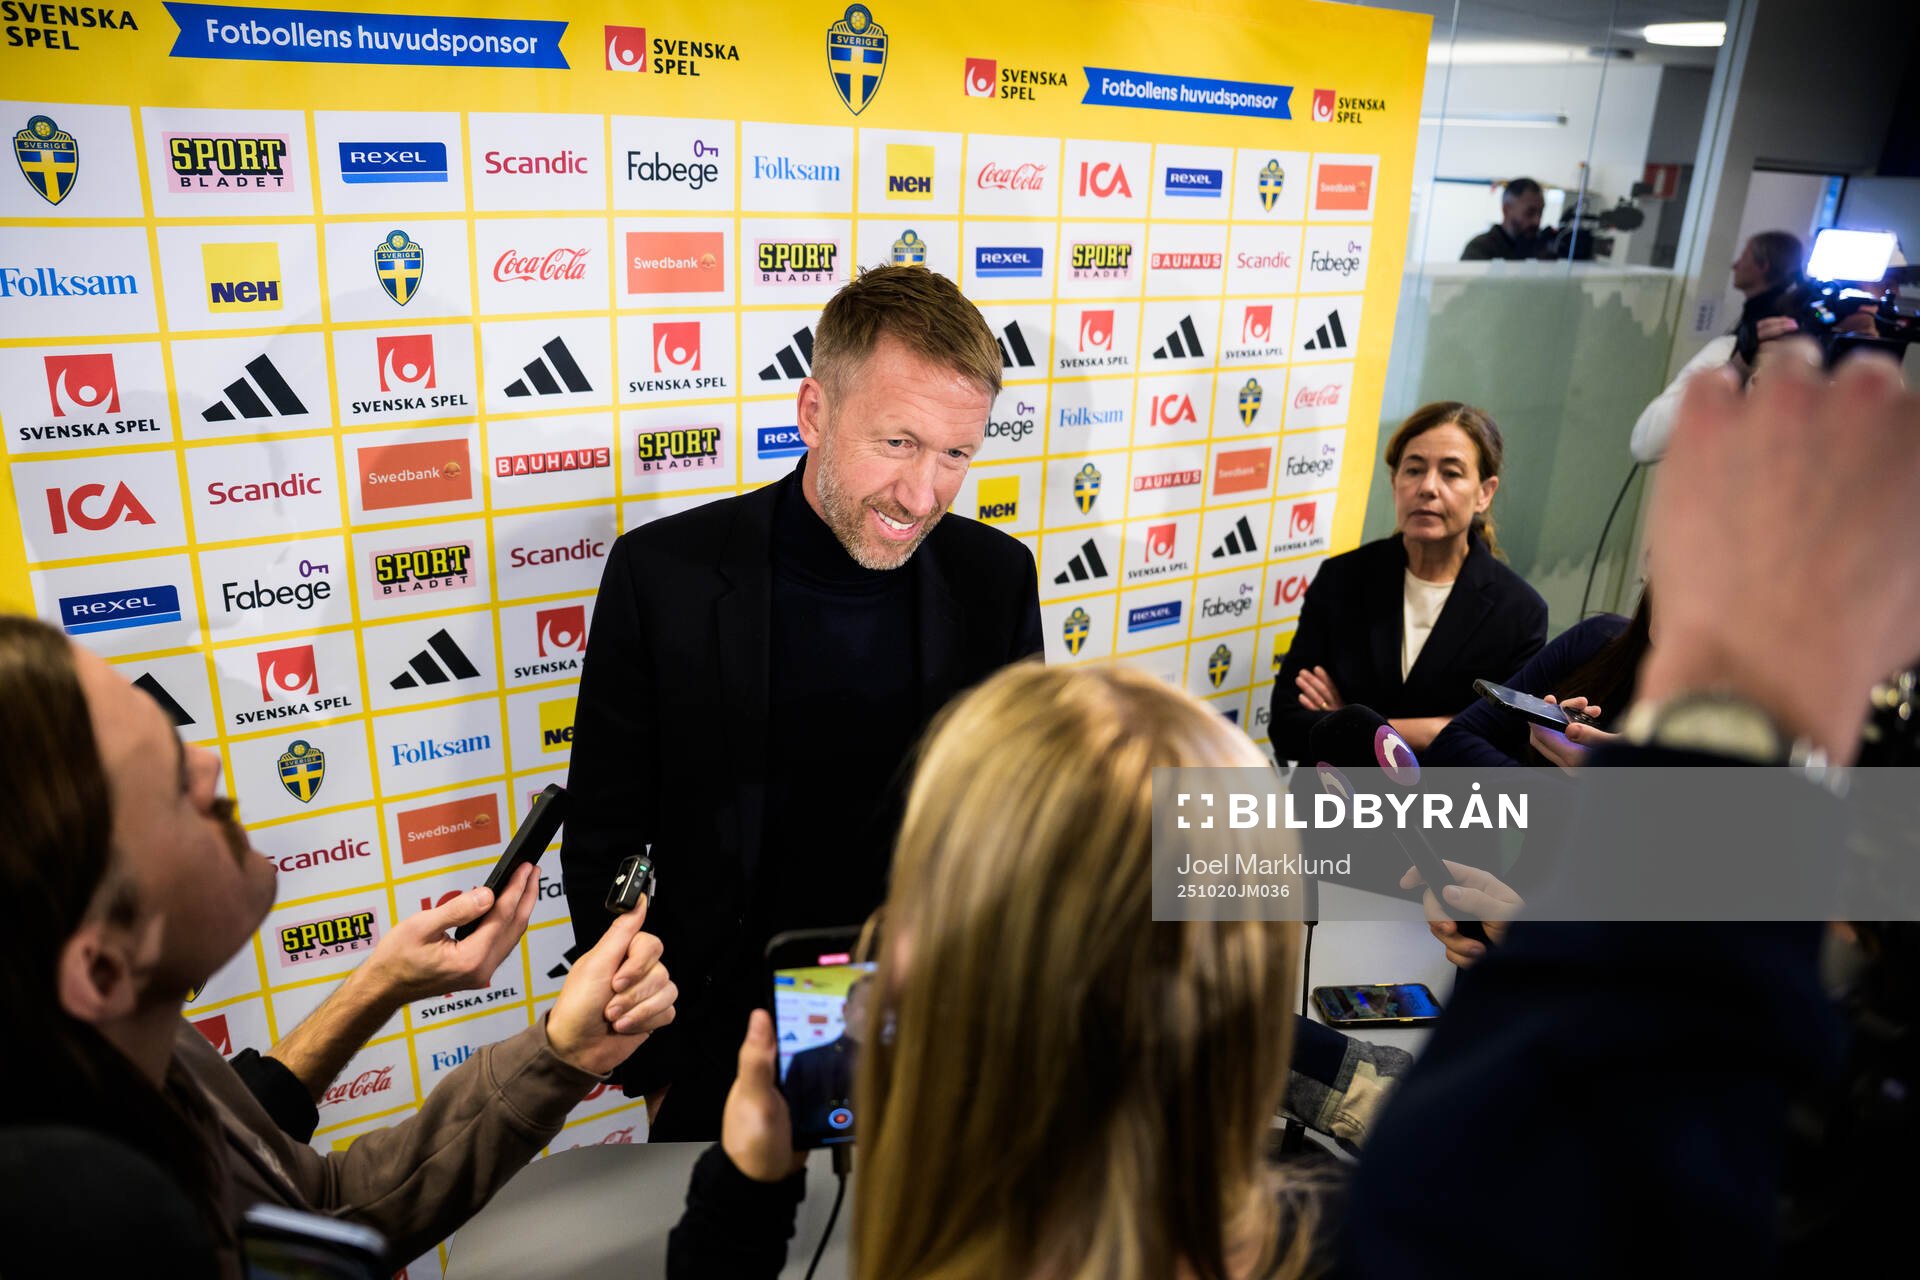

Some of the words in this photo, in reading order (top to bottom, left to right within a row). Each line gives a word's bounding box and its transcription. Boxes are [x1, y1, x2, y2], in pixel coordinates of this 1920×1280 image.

[3, 0, 139, 30] SVENSKA
[8, 26, 79, 50] SPEL
[206, 19, 352, 50] Fotbollens
[358, 24, 537, 57] huvudsponsor
[653, 38, 739, 61] SVENSKA
[836, 35, 879, 46] SVERIGE
[653, 58, 700, 76] SPEL
[1001, 69, 1068, 87] SVENSKA
[1001, 85, 1036, 101] SPEL
[1102, 78, 1178, 102] Fotbollens
[1180, 84, 1278, 110] huvudsponsor
[1338, 97, 1386, 111] SVENSKA
[1337, 111, 1363, 124] SPEL
[24, 141, 67, 150] SVERIGE
[171, 138, 287, 176] SPORT
[485, 150, 588, 175] Scandic
[627, 151, 719, 190] Fabege
[754, 155, 840, 182] Folksam
[180, 177, 285, 188] BLADET
[1079, 161, 1132, 198] ICA
[382, 250, 416, 260] SVERIGE
[633, 256, 698, 270] Swedbank
[758, 242, 837, 273] SPORT
[1072, 243, 1133, 269] SPORT
[1152, 253, 1222, 270] BAUHAUS
[1237, 251, 1291, 269] Scandic
[1310, 251, 1360, 276] Fabege
[0, 267, 139, 297] Folksam
[762, 273, 835, 282] BLADET
[1073, 269, 1131, 279] BLADET
[1060, 357, 1105, 369] SVENSKA
[1107, 356, 1129, 366] SPEL
[1225, 348, 1264, 359] SVENSKA
[1266, 347, 1284, 357] SPEL
[629, 378, 692, 393] SVENSKA
[695, 376, 727, 390] SPEL
[352, 397, 426, 414] SVENSKA
[431, 394, 468, 408] SPEL
[1150, 393, 1197, 427] ICA
[984, 416, 1034, 442] bege
[1059, 407, 1124, 428] Folksam
[20, 422, 109, 441] SVENSKA
[115, 418, 161, 434] SPEL
[639, 427, 721, 461] SPORT
[497, 447, 609, 475] BAUHAUS
[643, 457, 718, 471] BLADET
[1286, 456, 1333, 478] Fabege
[368, 466, 441, 484] Swedbank
[1134, 469, 1201, 491] BAUHAUS
[207, 472, 322, 505] Scandic
[46, 480, 157, 534] ICA
[511, 538, 605, 568] Scandic
[1274, 540, 1306, 553] SVENSKA
[1307, 537, 1324, 547] SPEL
[376, 545, 470, 585] SPORT
[1128, 564, 1166, 579] SVENSKA
[1168, 562, 1188, 573] SPEL
[222, 580, 331, 612] Fabege
[383, 575, 468, 594] BLADET
[1202, 595, 1251, 617] Fabege
[514, 660, 578, 679] SVENSKA
[235, 703, 311, 725] SVENSKA
[314, 696, 352, 713] SPEL
[285, 756, 317, 766] SVERIGE
[392, 734, 491, 767] Folksam
[408, 820, 472, 843] Swedbank
[282, 911, 374, 954] SPORT
[290, 938, 374, 962] BLADET
[421, 995, 483, 1019] SVENSKA
[486, 987, 518, 1003] SPEL
